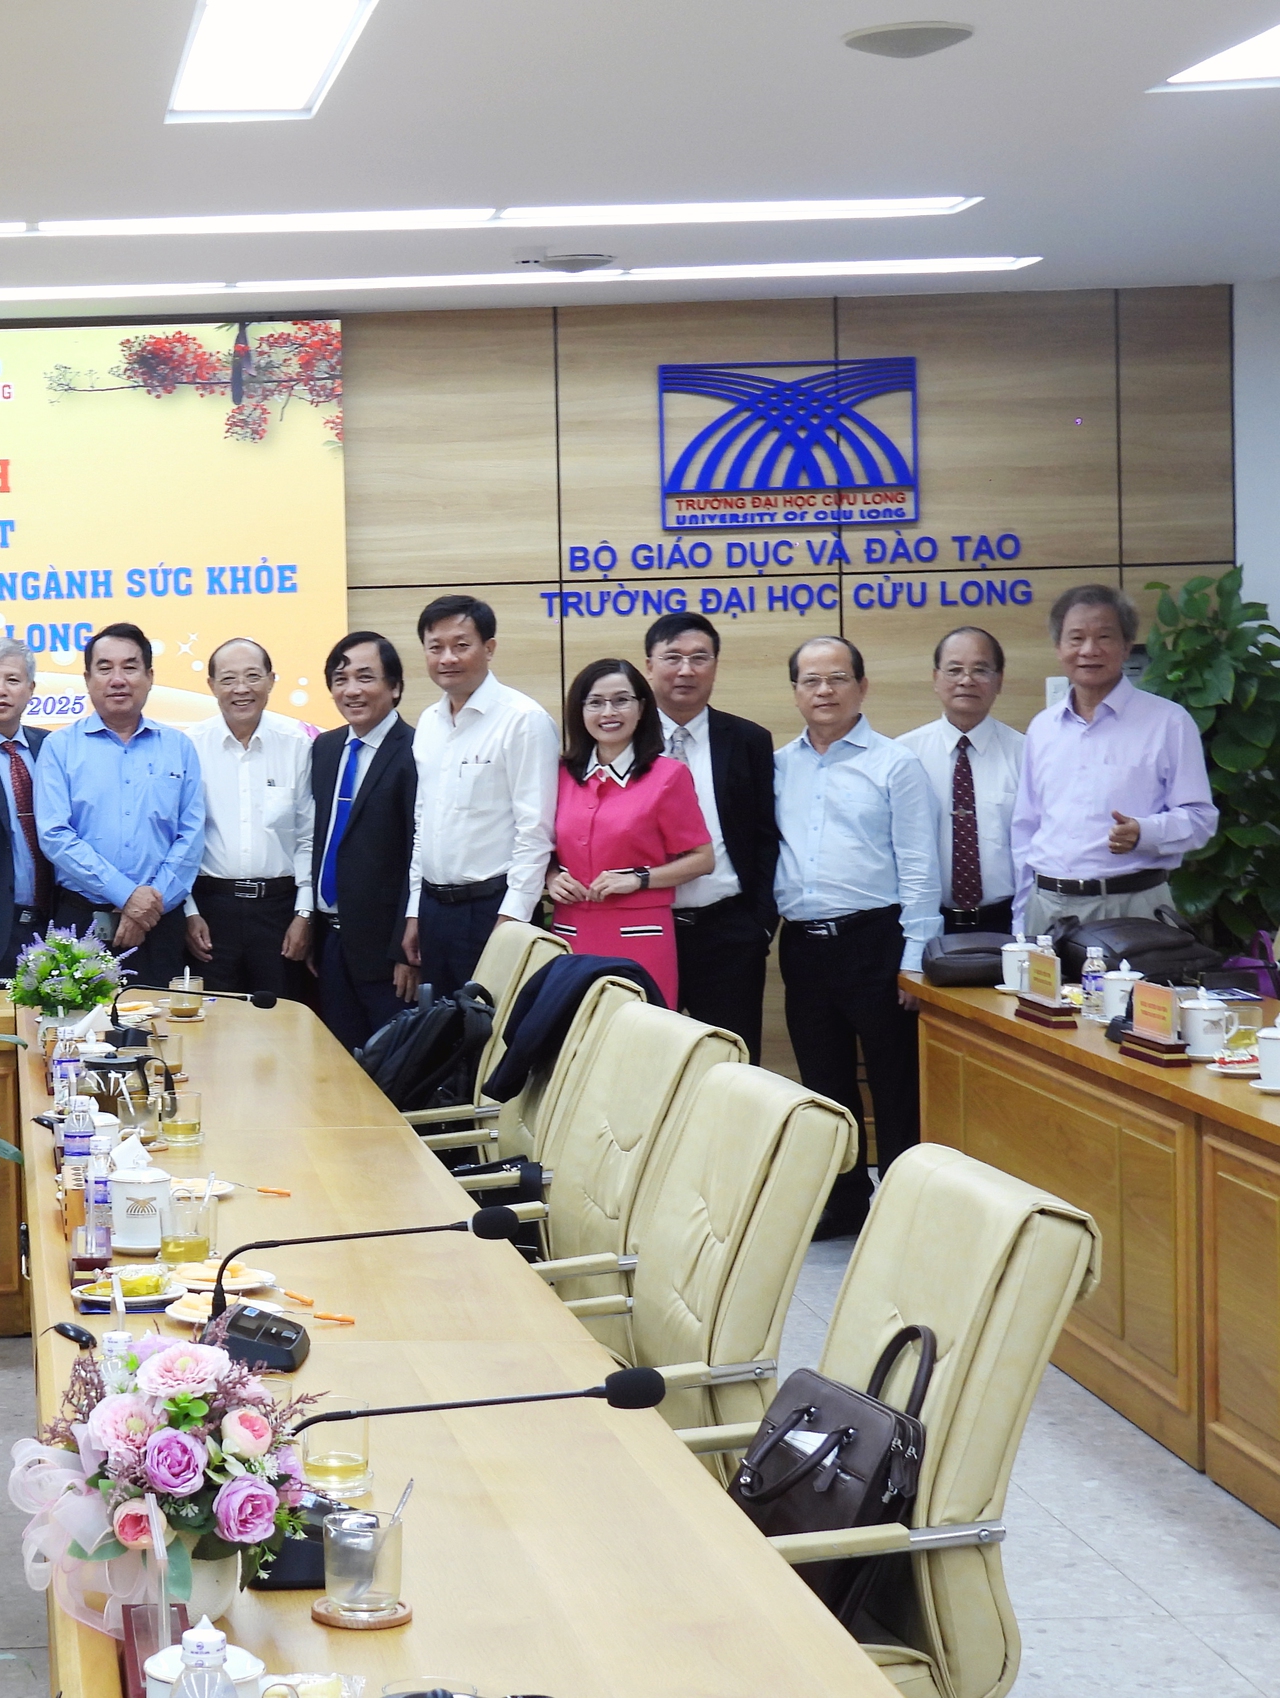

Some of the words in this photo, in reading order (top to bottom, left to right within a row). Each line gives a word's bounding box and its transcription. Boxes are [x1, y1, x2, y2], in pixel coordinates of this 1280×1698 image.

[676, 511, 778, 525] UNIVERSITY
[783, 510, 809, 521] OF
[859, 507, 907, 520] LONG
[783, 494, 817, 510] HỌC
[861, 491, 907, 505] LONG
[568, 541, 618, 579] BỘ
[631, 536, 713, 570] GIÁO
[726, 540, 794, 575] DỤC
[806, 531, 851, 566] VÀ
[863, 530, 939, 564] ĐÀO
[951, 533, 1021, 569] TẠO
[126, 562, 193, 598] SỨC
[205, 556, 298, 595] KHỎE
[540, 582, 688, 617] TRƯỜNG
[699, 585, 756, 620] ĐẠI
[767, 583, 839, 616] HỌC
[852, 574, 927, 608] CỬU
[939, 578, 1033, 606] LONG
[27, 696, 87, 716] 2025
